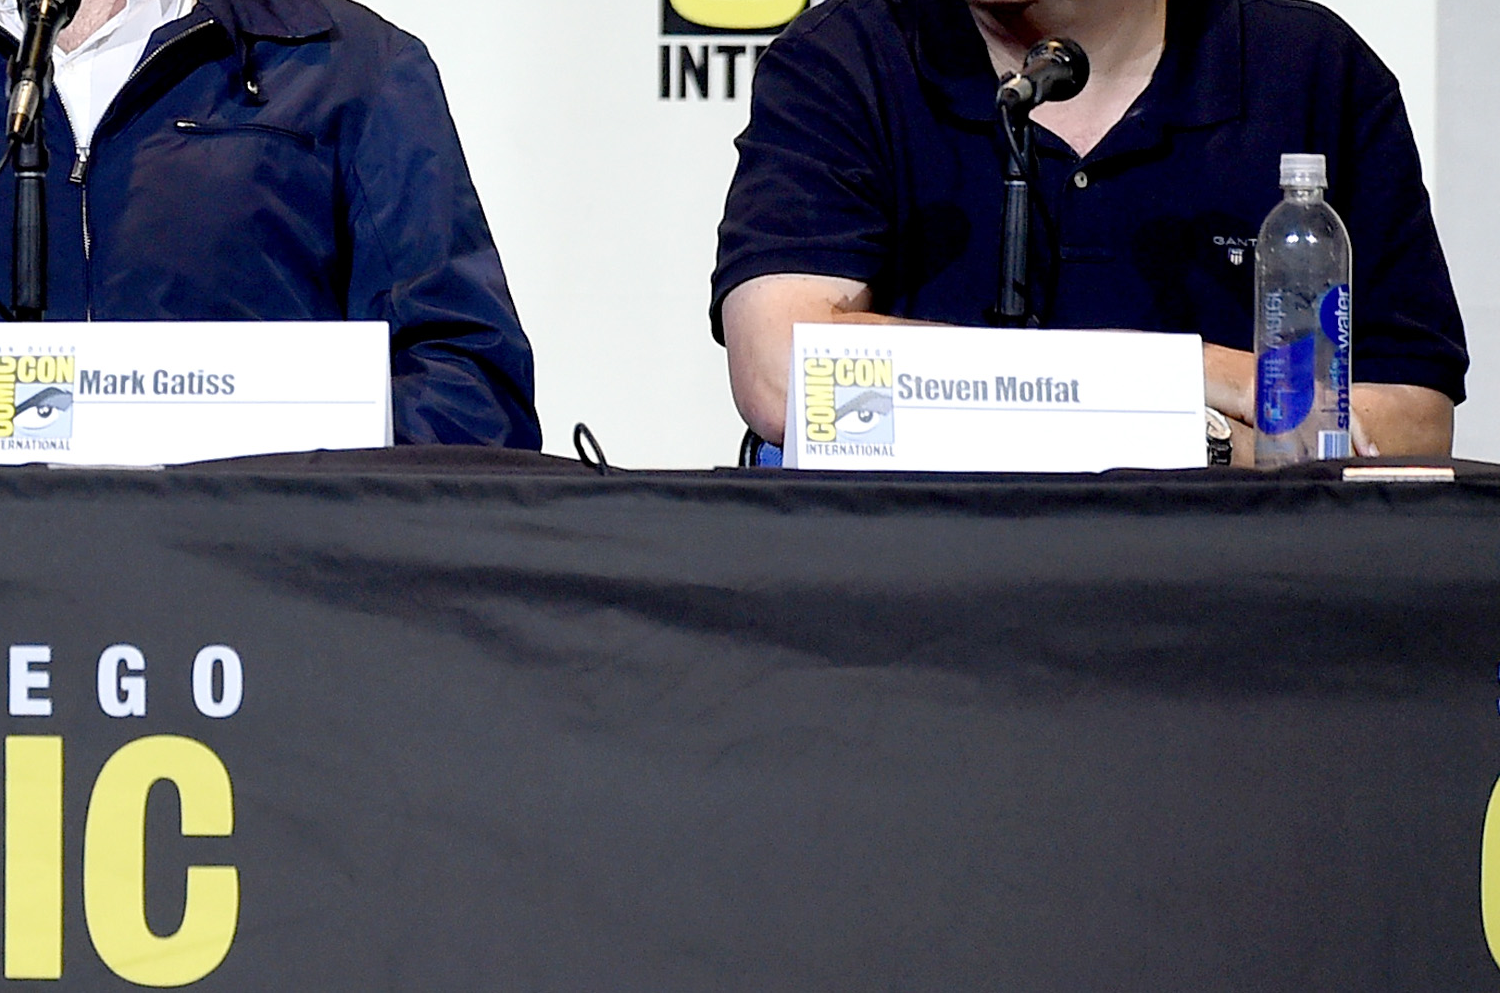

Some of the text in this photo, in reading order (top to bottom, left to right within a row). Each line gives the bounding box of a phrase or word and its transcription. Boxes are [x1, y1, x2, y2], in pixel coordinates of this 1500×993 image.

[1213, 236, 1258, 246] GANT
[17, 355, 75, 384] CON
[79, 369, 235, 396] Mark Gatiss
[834, 357, 893, 388] CON
[804, 358, 837, 442] COMIC
[897, 373, 1081, 404] Steven Moffat
[805, 443, 896, 457] INTERNATIONAL
